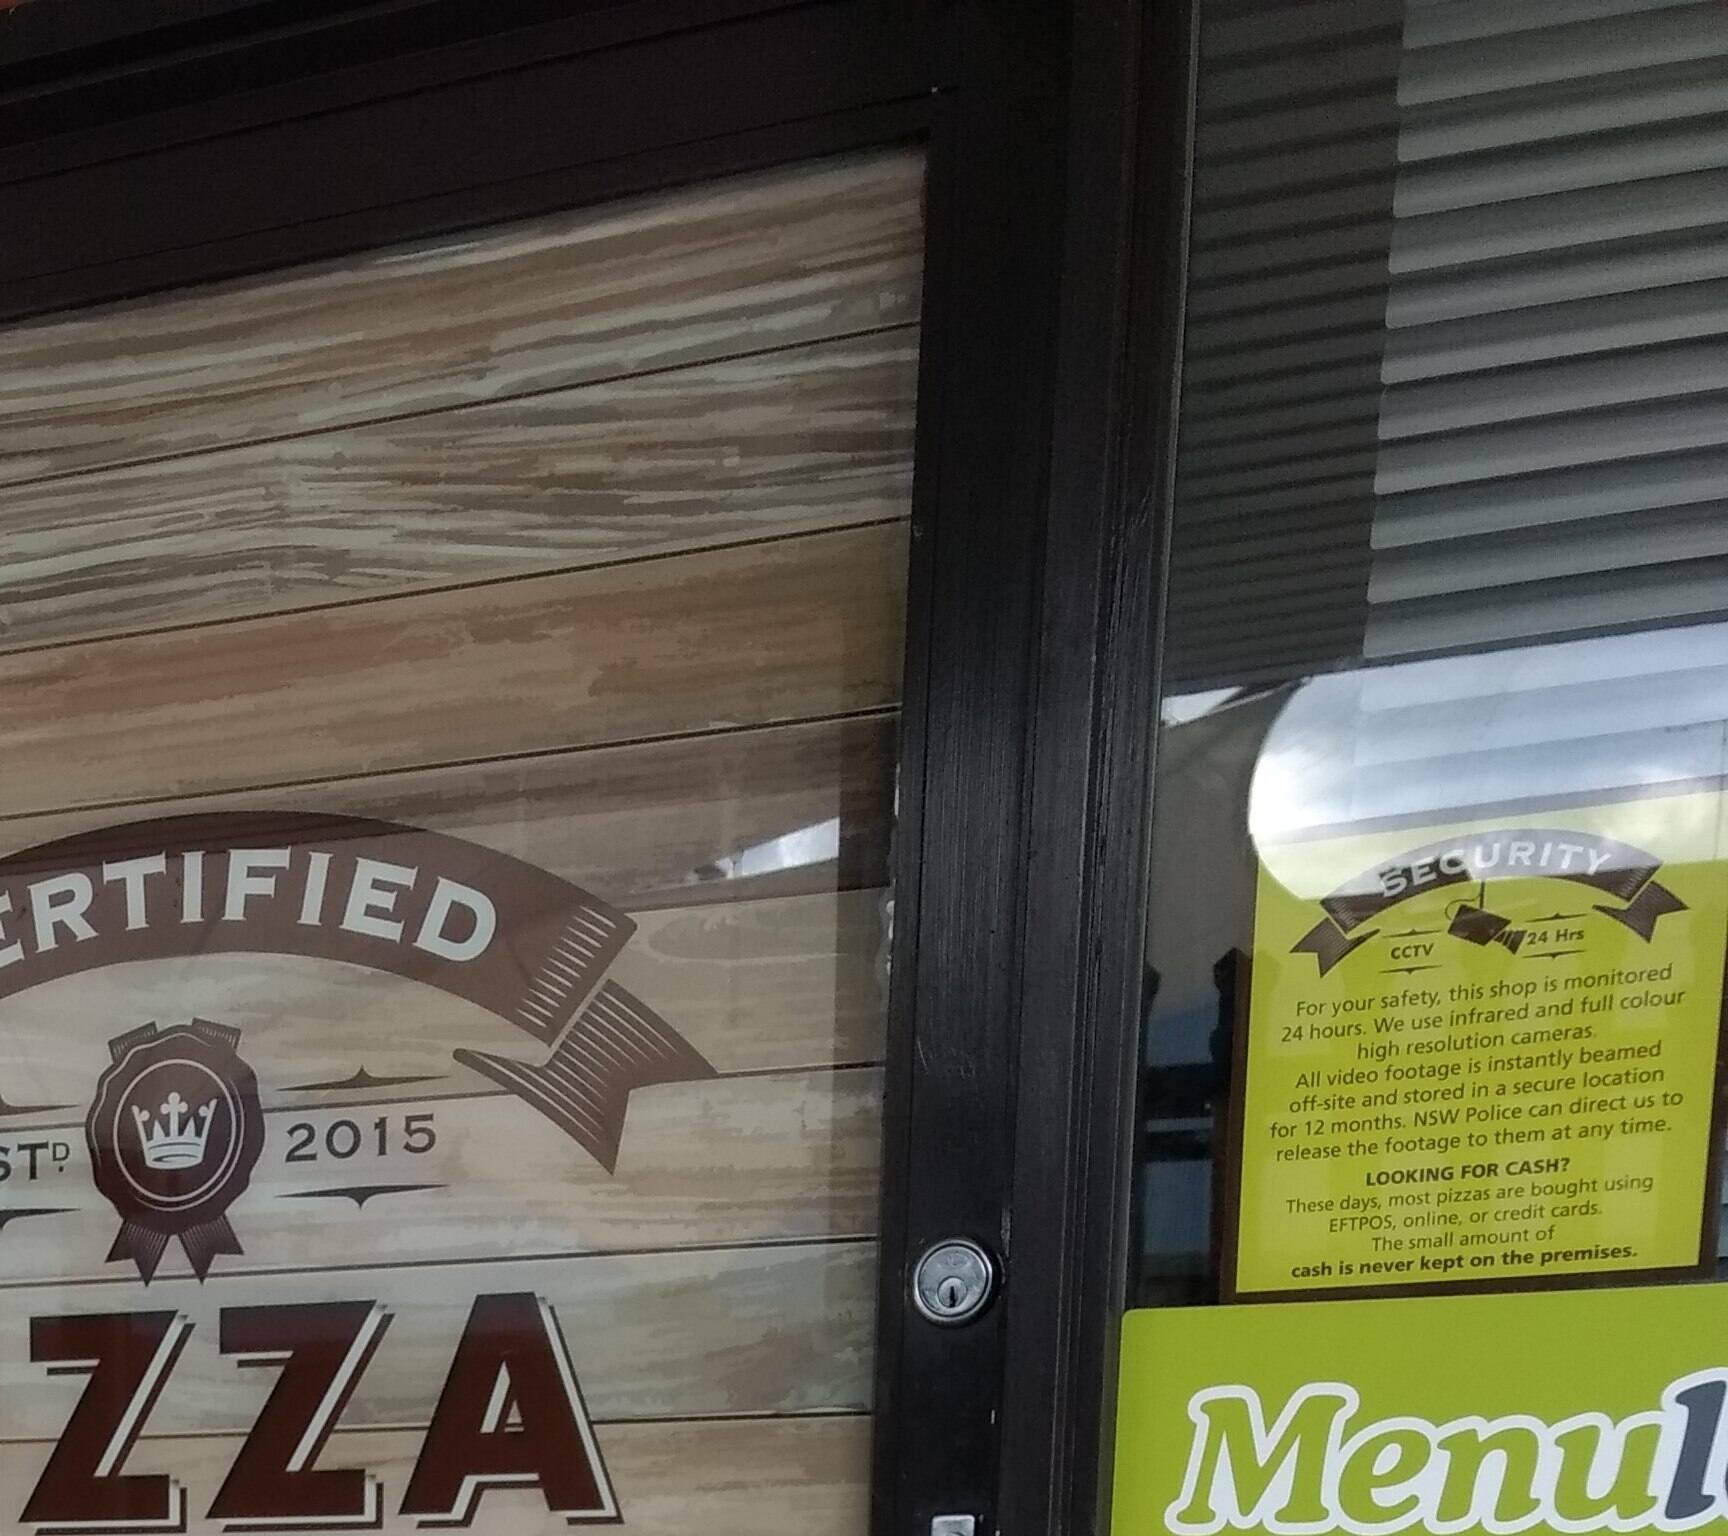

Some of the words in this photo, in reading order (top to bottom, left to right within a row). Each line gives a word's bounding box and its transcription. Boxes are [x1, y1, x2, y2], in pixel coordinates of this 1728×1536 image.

[1381, 841, 1611, 898] SECURITY
[1391, 943, 1434, 960] CCTV
[1526, 931, 1548, 946] 24
[1556, 928, 1585, 944] Hrs
[1297, 1001, 1326, 1016] For
[1332, 998, 1375, 1017] your
[1381, 990, 1440, 1008] safety,
[1449, 984, 1483, 1001] this
[1490, 980, 1537, 998] shop
[1545, 976, 1557, 992] is
[1564, 963, 1672, 990] monitored
[1282, 1026, 1302, 1042] 24
[1310, 1024, 1366, 1039] hours.
[1374, 1017, 1404, 1033] We
[1412, 1016, 1442, 1030] use
[1450, 1003, 1528, 1026] infrared
[1536, 998, 1573, 1018] and
[1581, 994, 1613, 1013] full
[1620, 990, 1685, 1009] colour
[1296, 1071, 1320, 1088] All
[1327, 1068, 1378, 1086] video
[1385, 1064, 1461, 1080] footage
[1468, 1058, 1480, 1073] is
[1488, 1049, 1573, 1072] instantly
[1580, 1040, 1662, 1063] beamed
[1358, 1040, 1399, 1062] high
[1407, 1032, 1504, 1054] resolution
[1511, 1026, 1597, 1045] cameras.
[1290, 1094, 1355, 1112] off-site
[1362, 1088, 1397, 1107] and
[1404, 1083, 1464, 1104] stored
[1472, 1082, 1488, 1098] in
[1496, 1084, 1506, 1096] a
[1513, 1078, 1575, 1094] secure
[1584, 1068, 1664, 1087] location
[1270, 1122, 1297, 1138] for
[1305, 1120, 1324, 1136] 12
[1332, 1114, 1406, 1134] months.
[1414, 1108, 1460, 1127] NSW
[1466, 1104, 1522, 1122] Police
[1529, 1104, 1562, 1117] can
[1570, 1096, 1626, 1114] direct
[1634, 1096, 1654, 1108] us
[1662, 1092, 1683, 1106] to
[284, 1115, 437, 1165] 2015
[1277, 1144, 1341, 1162] release
[1347, 1140, 1378, 1156] the
[1385, 1136, 1460, 1153] footage
[1468, 1133, 1487, 1146] to
[1494, 1128, 1544, 1144] them
[1552, 1125, 1571, 1140] at
[1578, 1124, 1614, 1140] any
[1620, 1117, 1671, 1134] time.
[1286, 1198, 1334, 1213] These
[1340, 1195, 1381, 1212] days,
[1389, 1192, 1430, 1206] most
[1437, 1188, 1490, 1207] pizzas
[1496, 1187, 1524, 1199] are
[1532, 1178, 1597, 1198] bought
[1605, 1175, 1653, 1192] using
[1366, 1166, 1454, 1186] LOOKING
[1461, 1164, 1498, 1179] FOR
[1506, 1158, 1570, 1176] CASH?
[1330, 1215, 1396, 1232] EFTPOS,
[1404, 1212, 1462, 1227] online,
[1470, 1212, 1488, 1223] or
[1494, 1204, 1545, 1221] credit
[1551, 1200, 1602, 1217] cards.
[1372, 1236, 1402, 1251] The
[1409, 1232, 1453, 1249] small
[1460, 1230, 1528, 1246] amount
[1536, 1225, 1555, 1240] of
[1292, 1262, 1332, 1277] cash
[1340, 1261, 1353, 1274] is
[1360, 1260, 1414, 1274] never
[1421, 1255, 1464, 1272] kept
[1470, 1256, 1494, 1266] on
[1502, 1250, 1534, 1264] the
[1541, 1245, 1637, 1266] premises.
[1165, 1367, 1728, 1536] Menul
